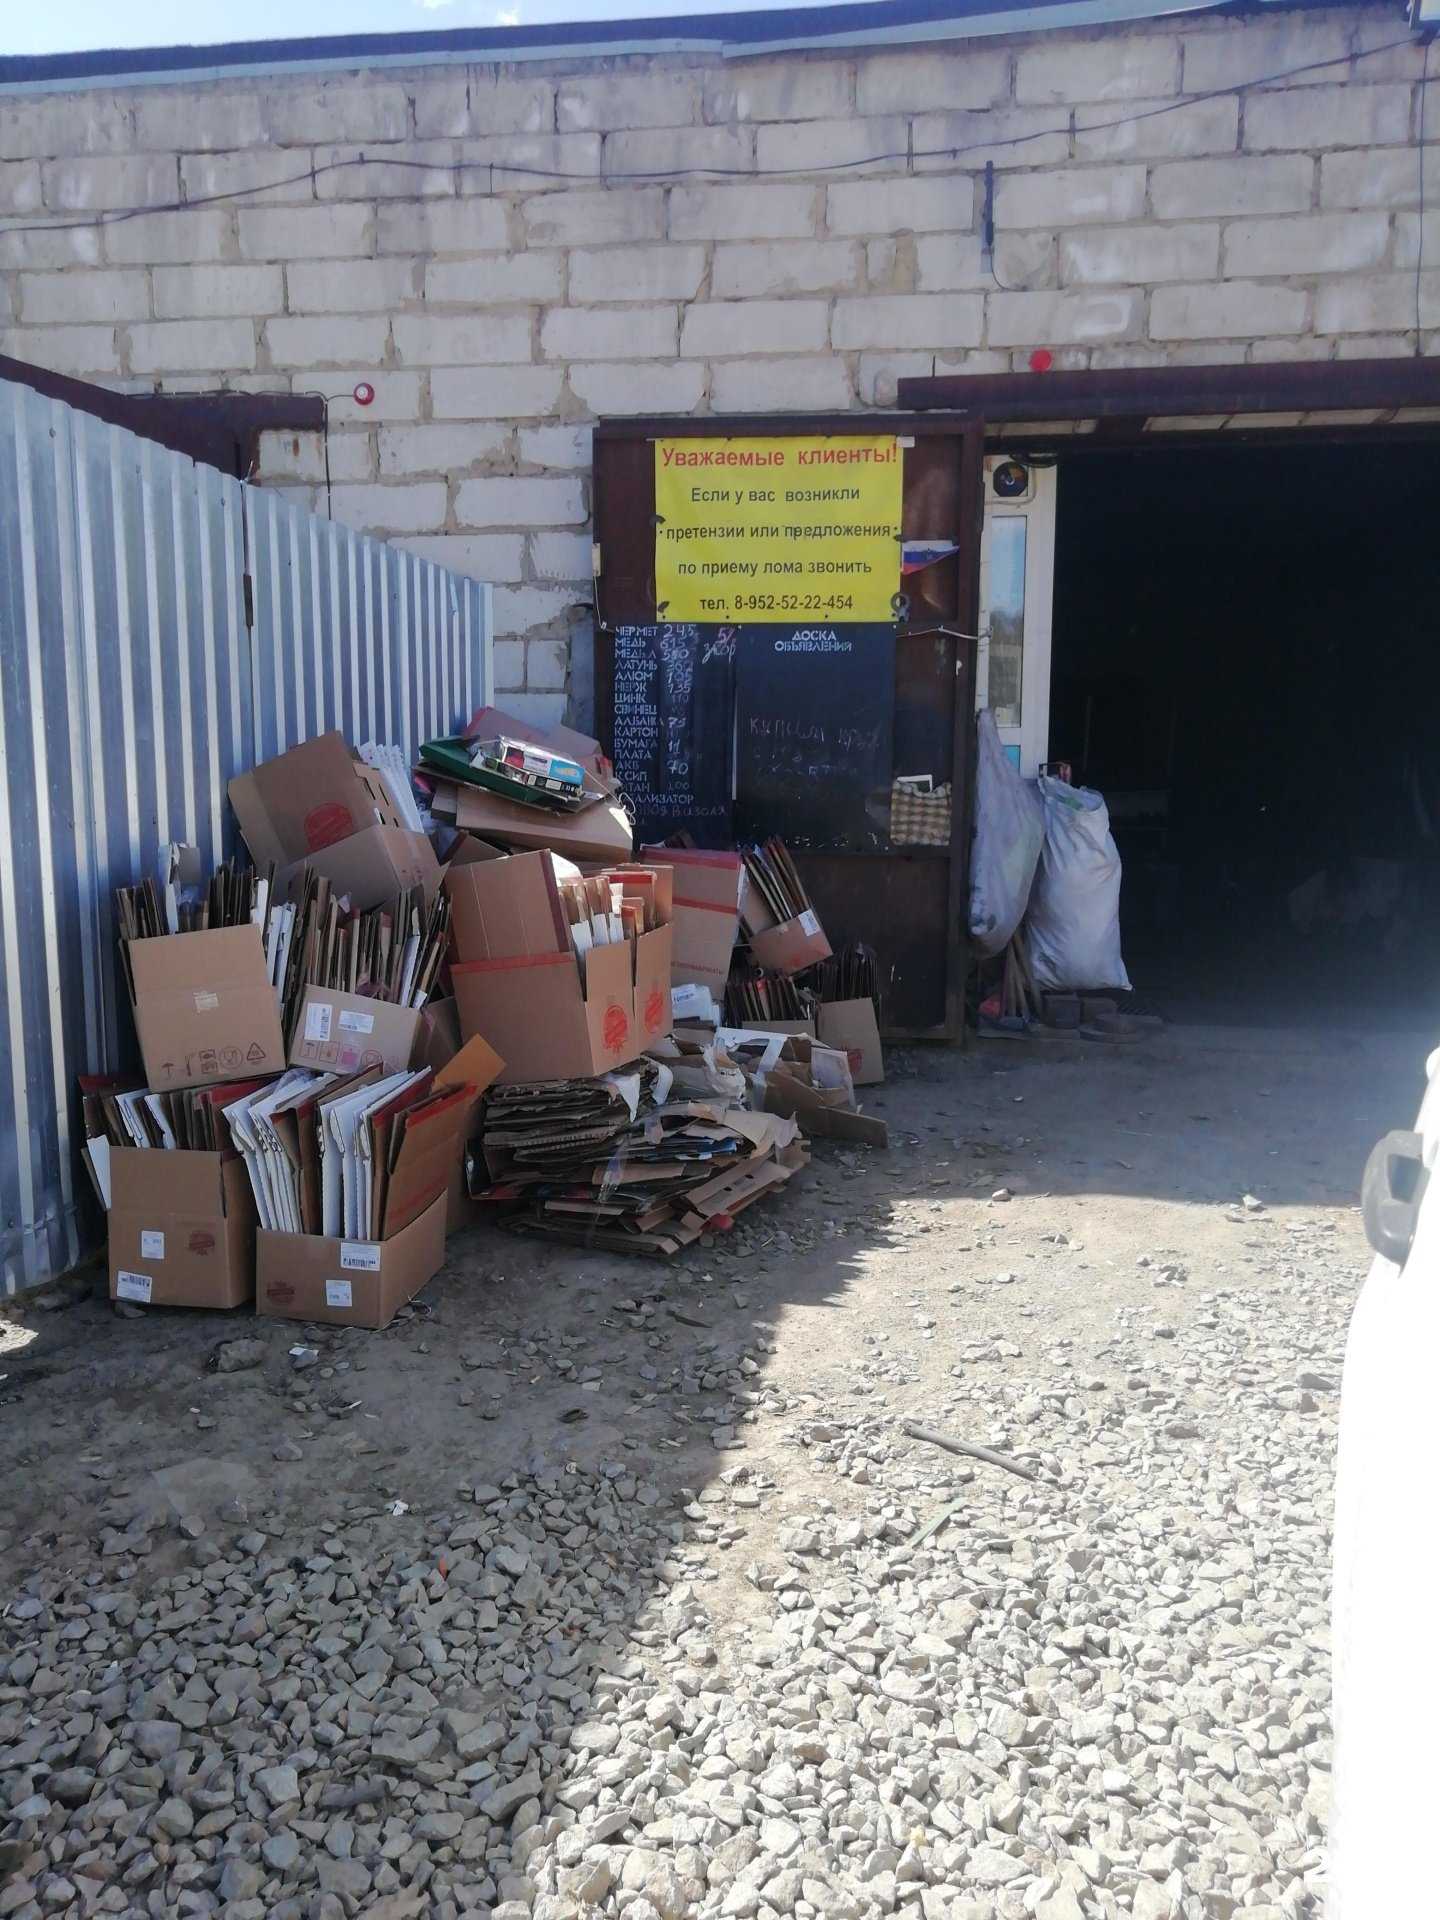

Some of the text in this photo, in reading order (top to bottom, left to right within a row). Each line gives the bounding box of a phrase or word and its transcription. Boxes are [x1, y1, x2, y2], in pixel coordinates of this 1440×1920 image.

[662, 442, 897, 468] Уважаемые клиенты!
[691, 487, 860, 505] Если у вас возникли
[666, 525, 891, 543] претензии или предложения
[678, 560, 872, 578] по приему лома звонить
[700, 595, 853, 610] тел. 8-952-52-22-454
[615, 626, 658, 636] ЧЕРМЕТ
[792, 630, 837, 641] ДОСКА
[615, 637, 646, 648] МЕДЬ
[615, 660, 658, 670] ЛАТУНЬ
[614, 671, 653, 681] АЛЮМ
[615, 682, 647, 692] НЕРЖ
[615, 693, 647, 703] ЦИНК
[614, 704, 657, 715] СВИНЕЦ
[615, 727, 658, 737] КАРТОН
[614, 738, 658, 748] БУМАГА
[614, 749, 652, 760] ПЛАТА
